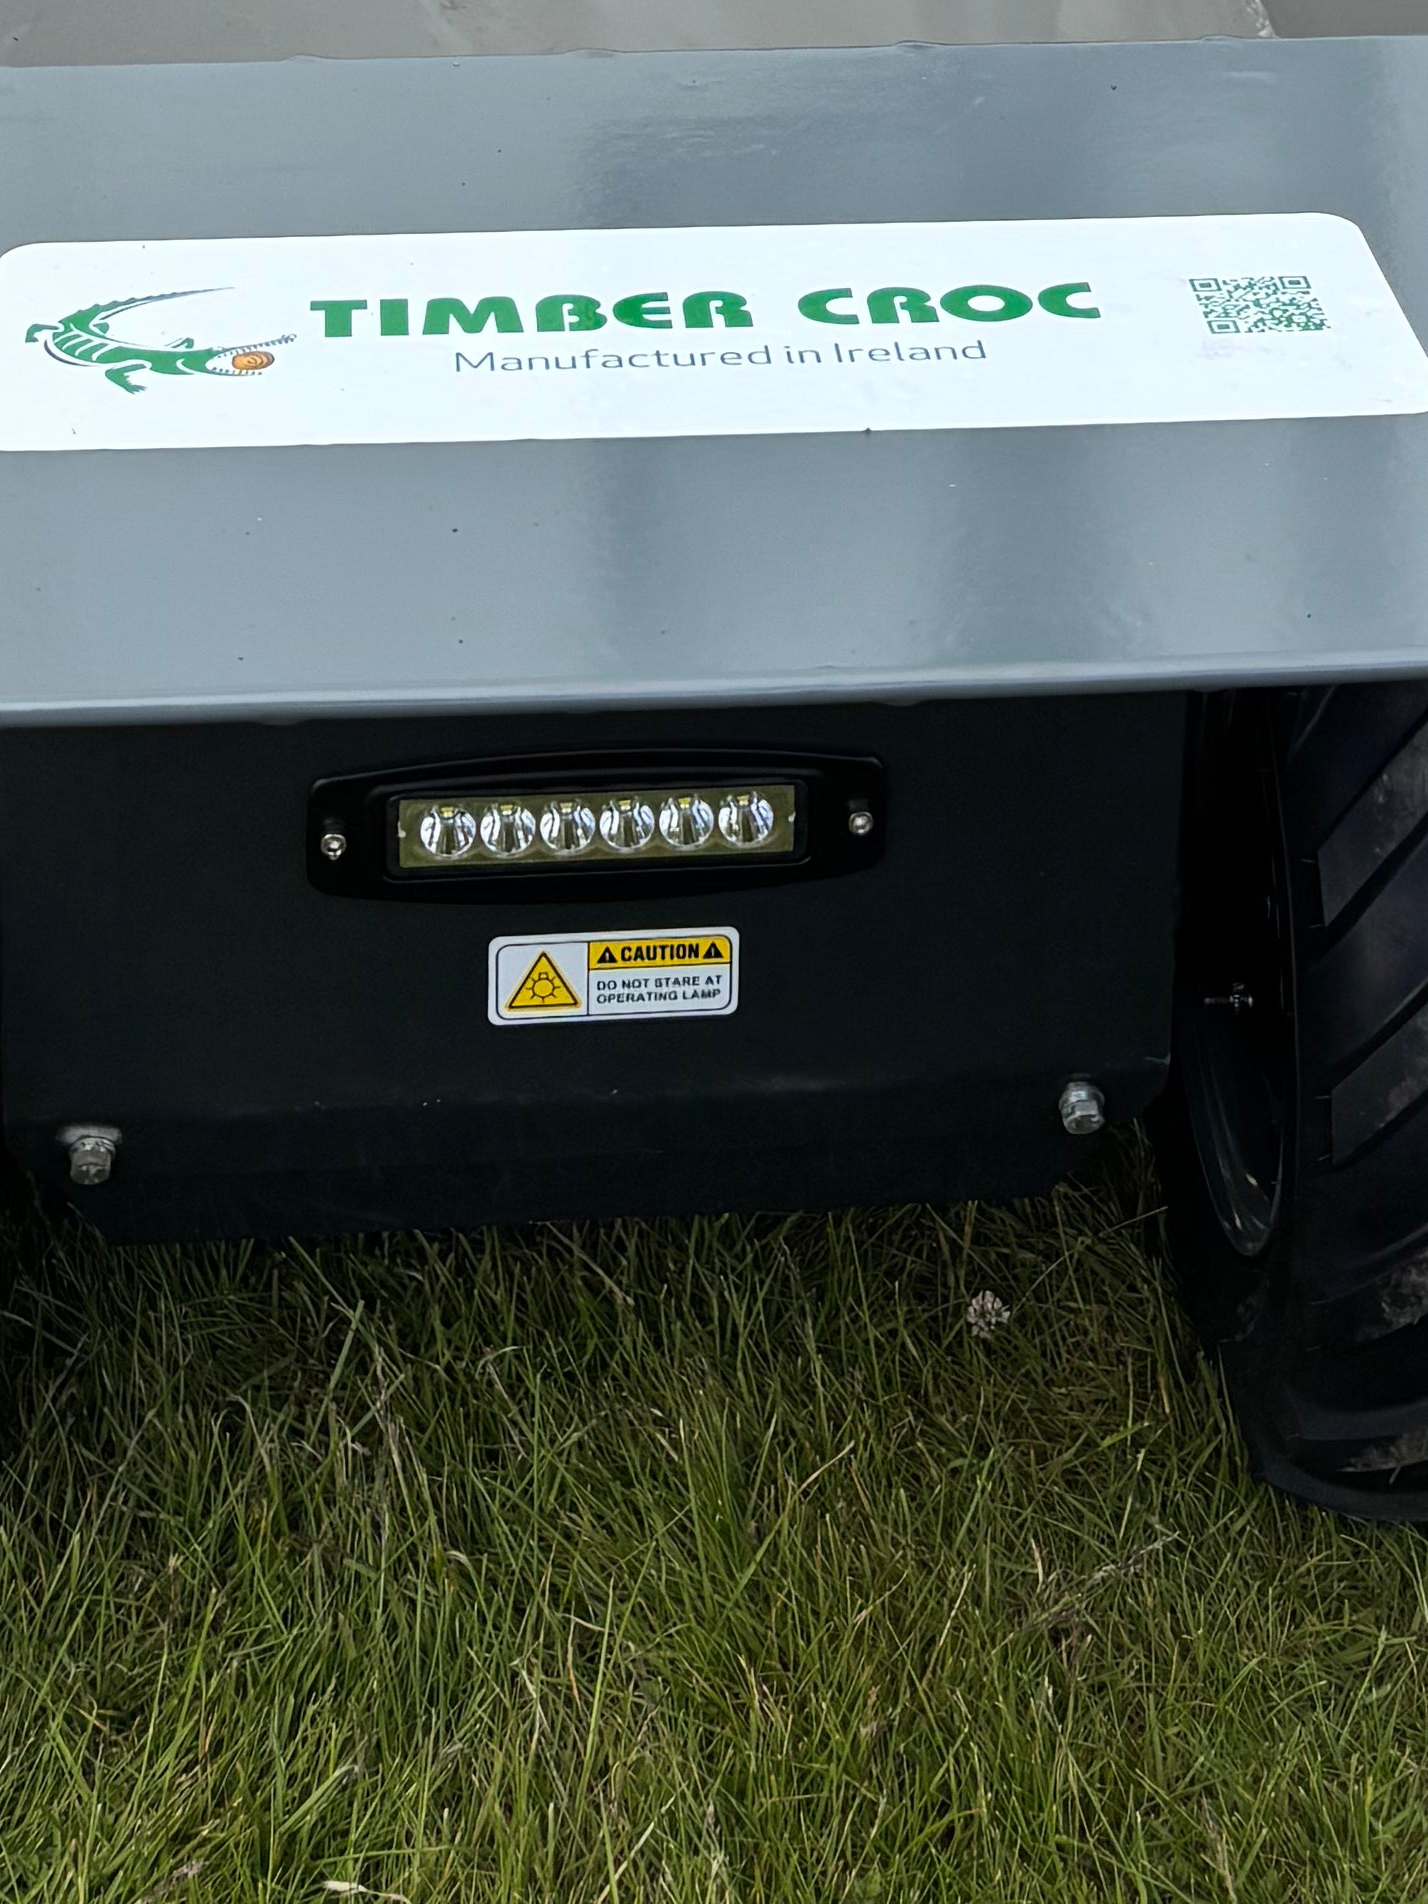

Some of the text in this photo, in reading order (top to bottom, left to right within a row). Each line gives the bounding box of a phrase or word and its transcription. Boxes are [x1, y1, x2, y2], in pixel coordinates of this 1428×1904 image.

[309, 282, 1101, 338] TIMBER CROC
[454, 340, 987, 373] Manufactured in Ireland
[620, 942, 700, 962] CAUTION
[596, 974, 722, 991] DO NOT STARE AT
[596, 988, 721, 1004] OPERATING LAMP
